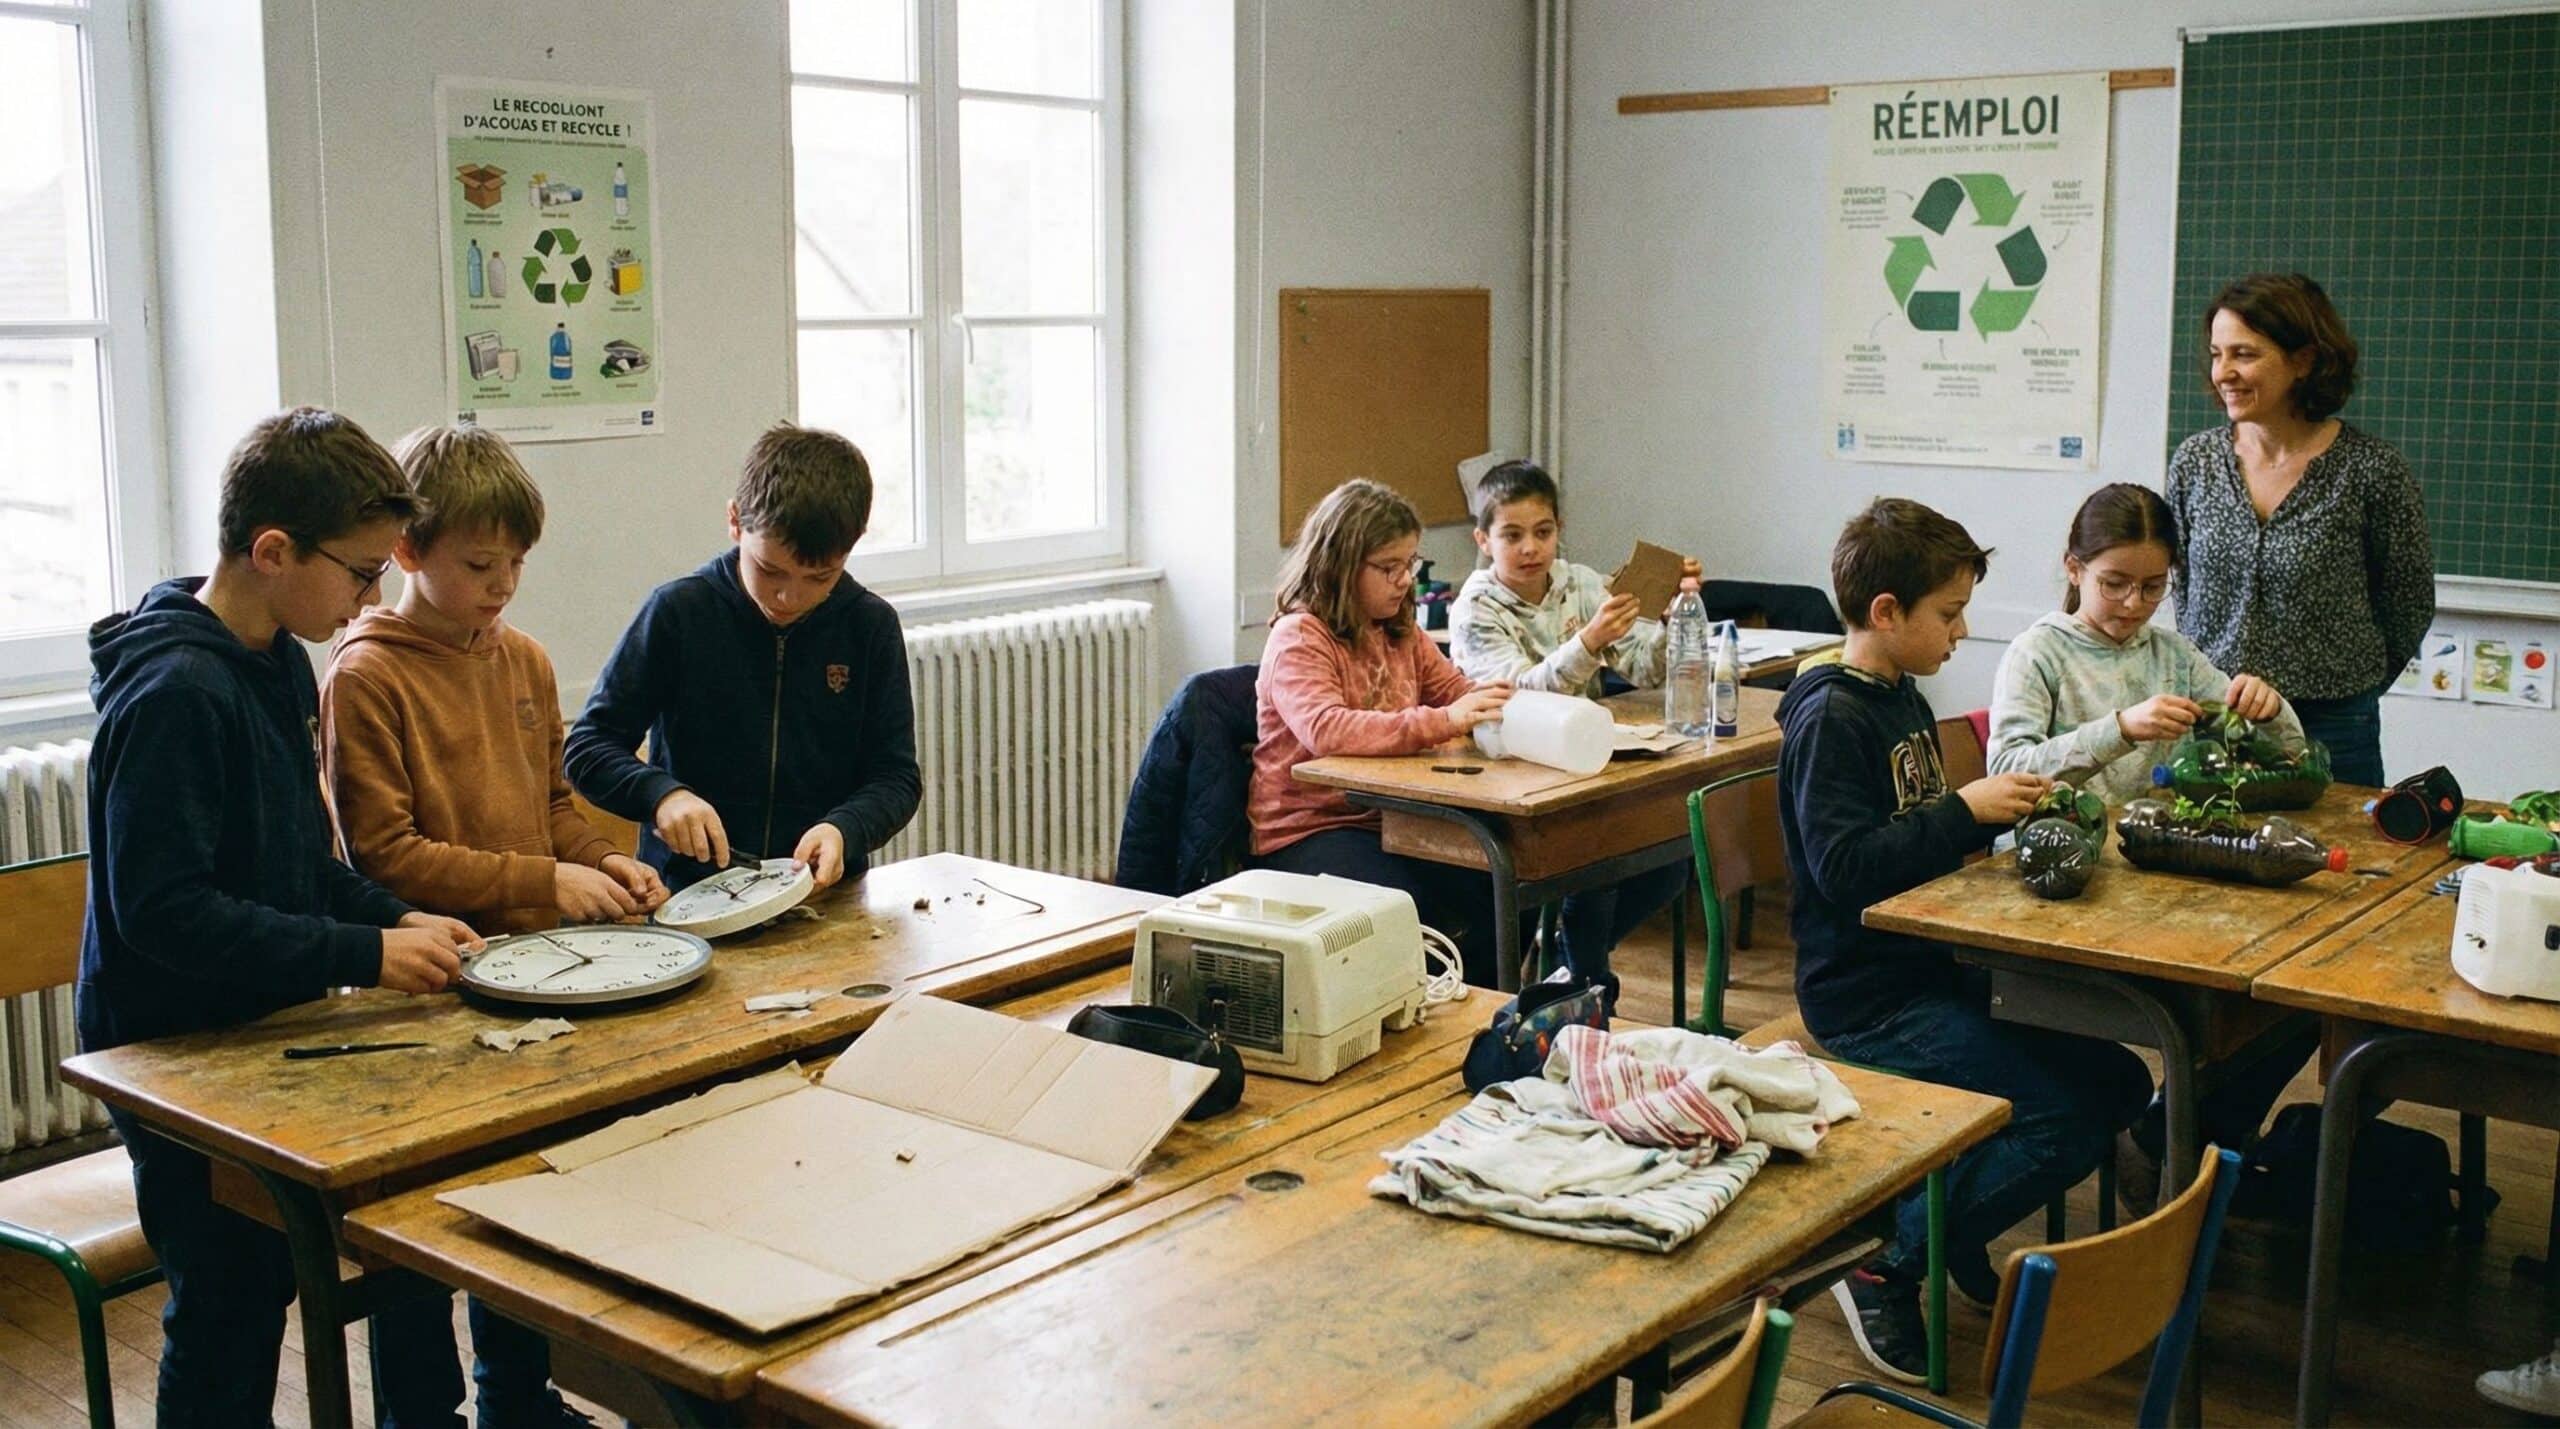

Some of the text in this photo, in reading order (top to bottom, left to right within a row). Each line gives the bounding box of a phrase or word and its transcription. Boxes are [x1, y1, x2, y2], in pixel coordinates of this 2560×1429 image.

[493, 98, 510, 112] LE
[1874, 90, 2059, 141] RÉEMPLOI
[542, 120, 557, 133] ET
[561, 121, 621, 137] RECYCLE
